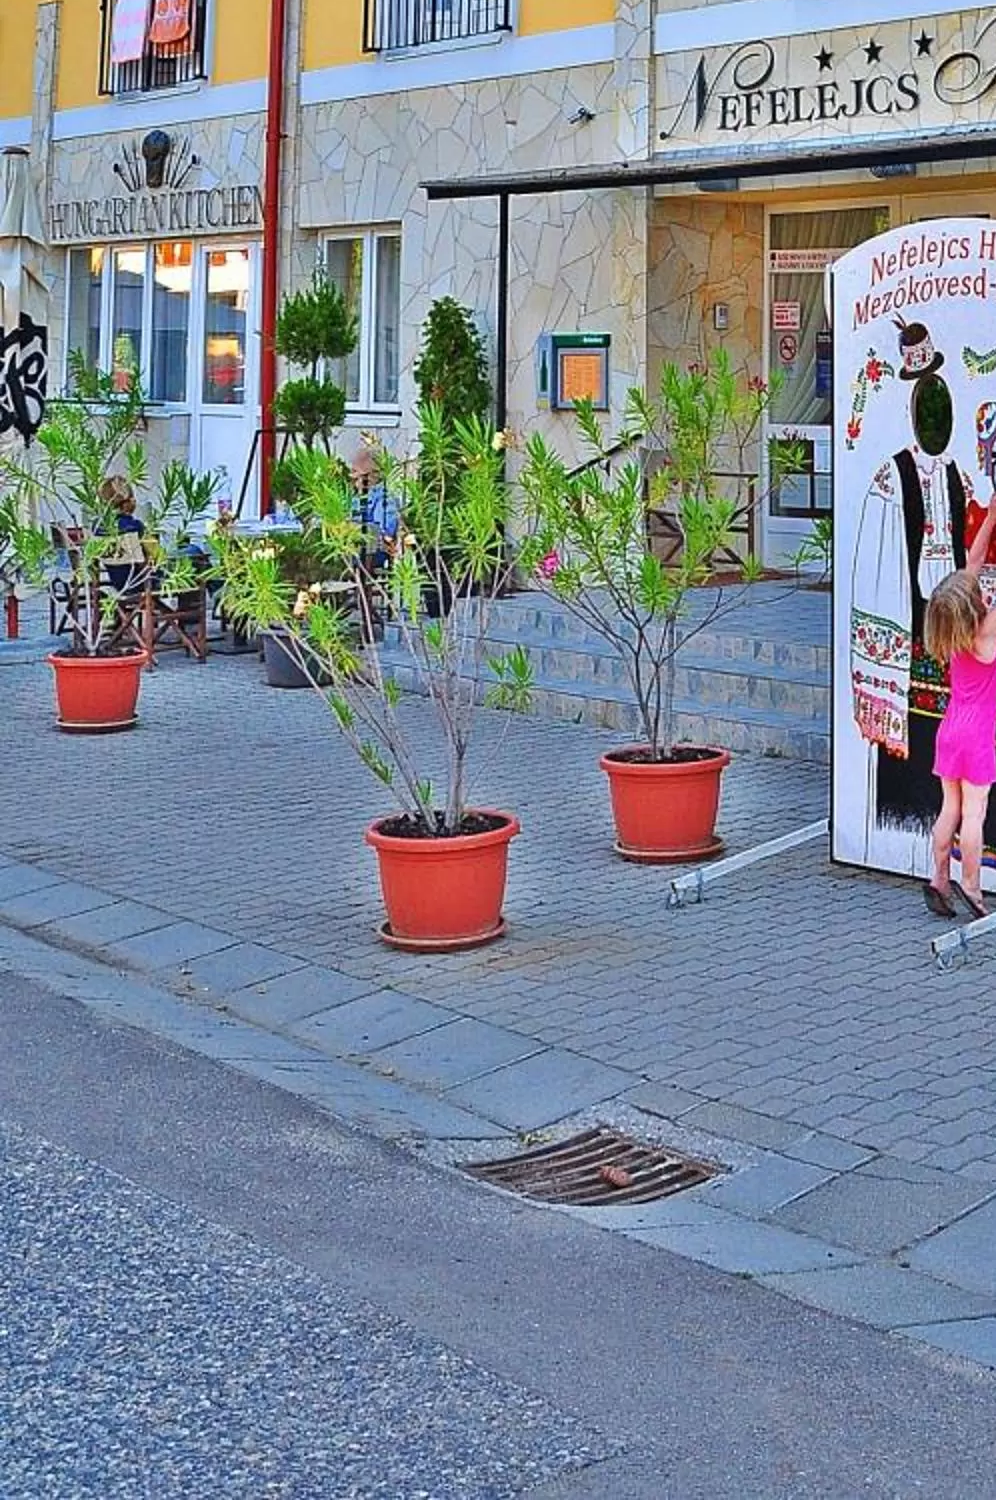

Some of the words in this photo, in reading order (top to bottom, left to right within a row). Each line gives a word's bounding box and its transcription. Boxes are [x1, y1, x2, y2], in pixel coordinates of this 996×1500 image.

[660, 41, 919, 140] NEFELEJCS
[50, 194, 164, 240] HUNGARIAN
[871, 232, 971, 286] Nefelejcs
